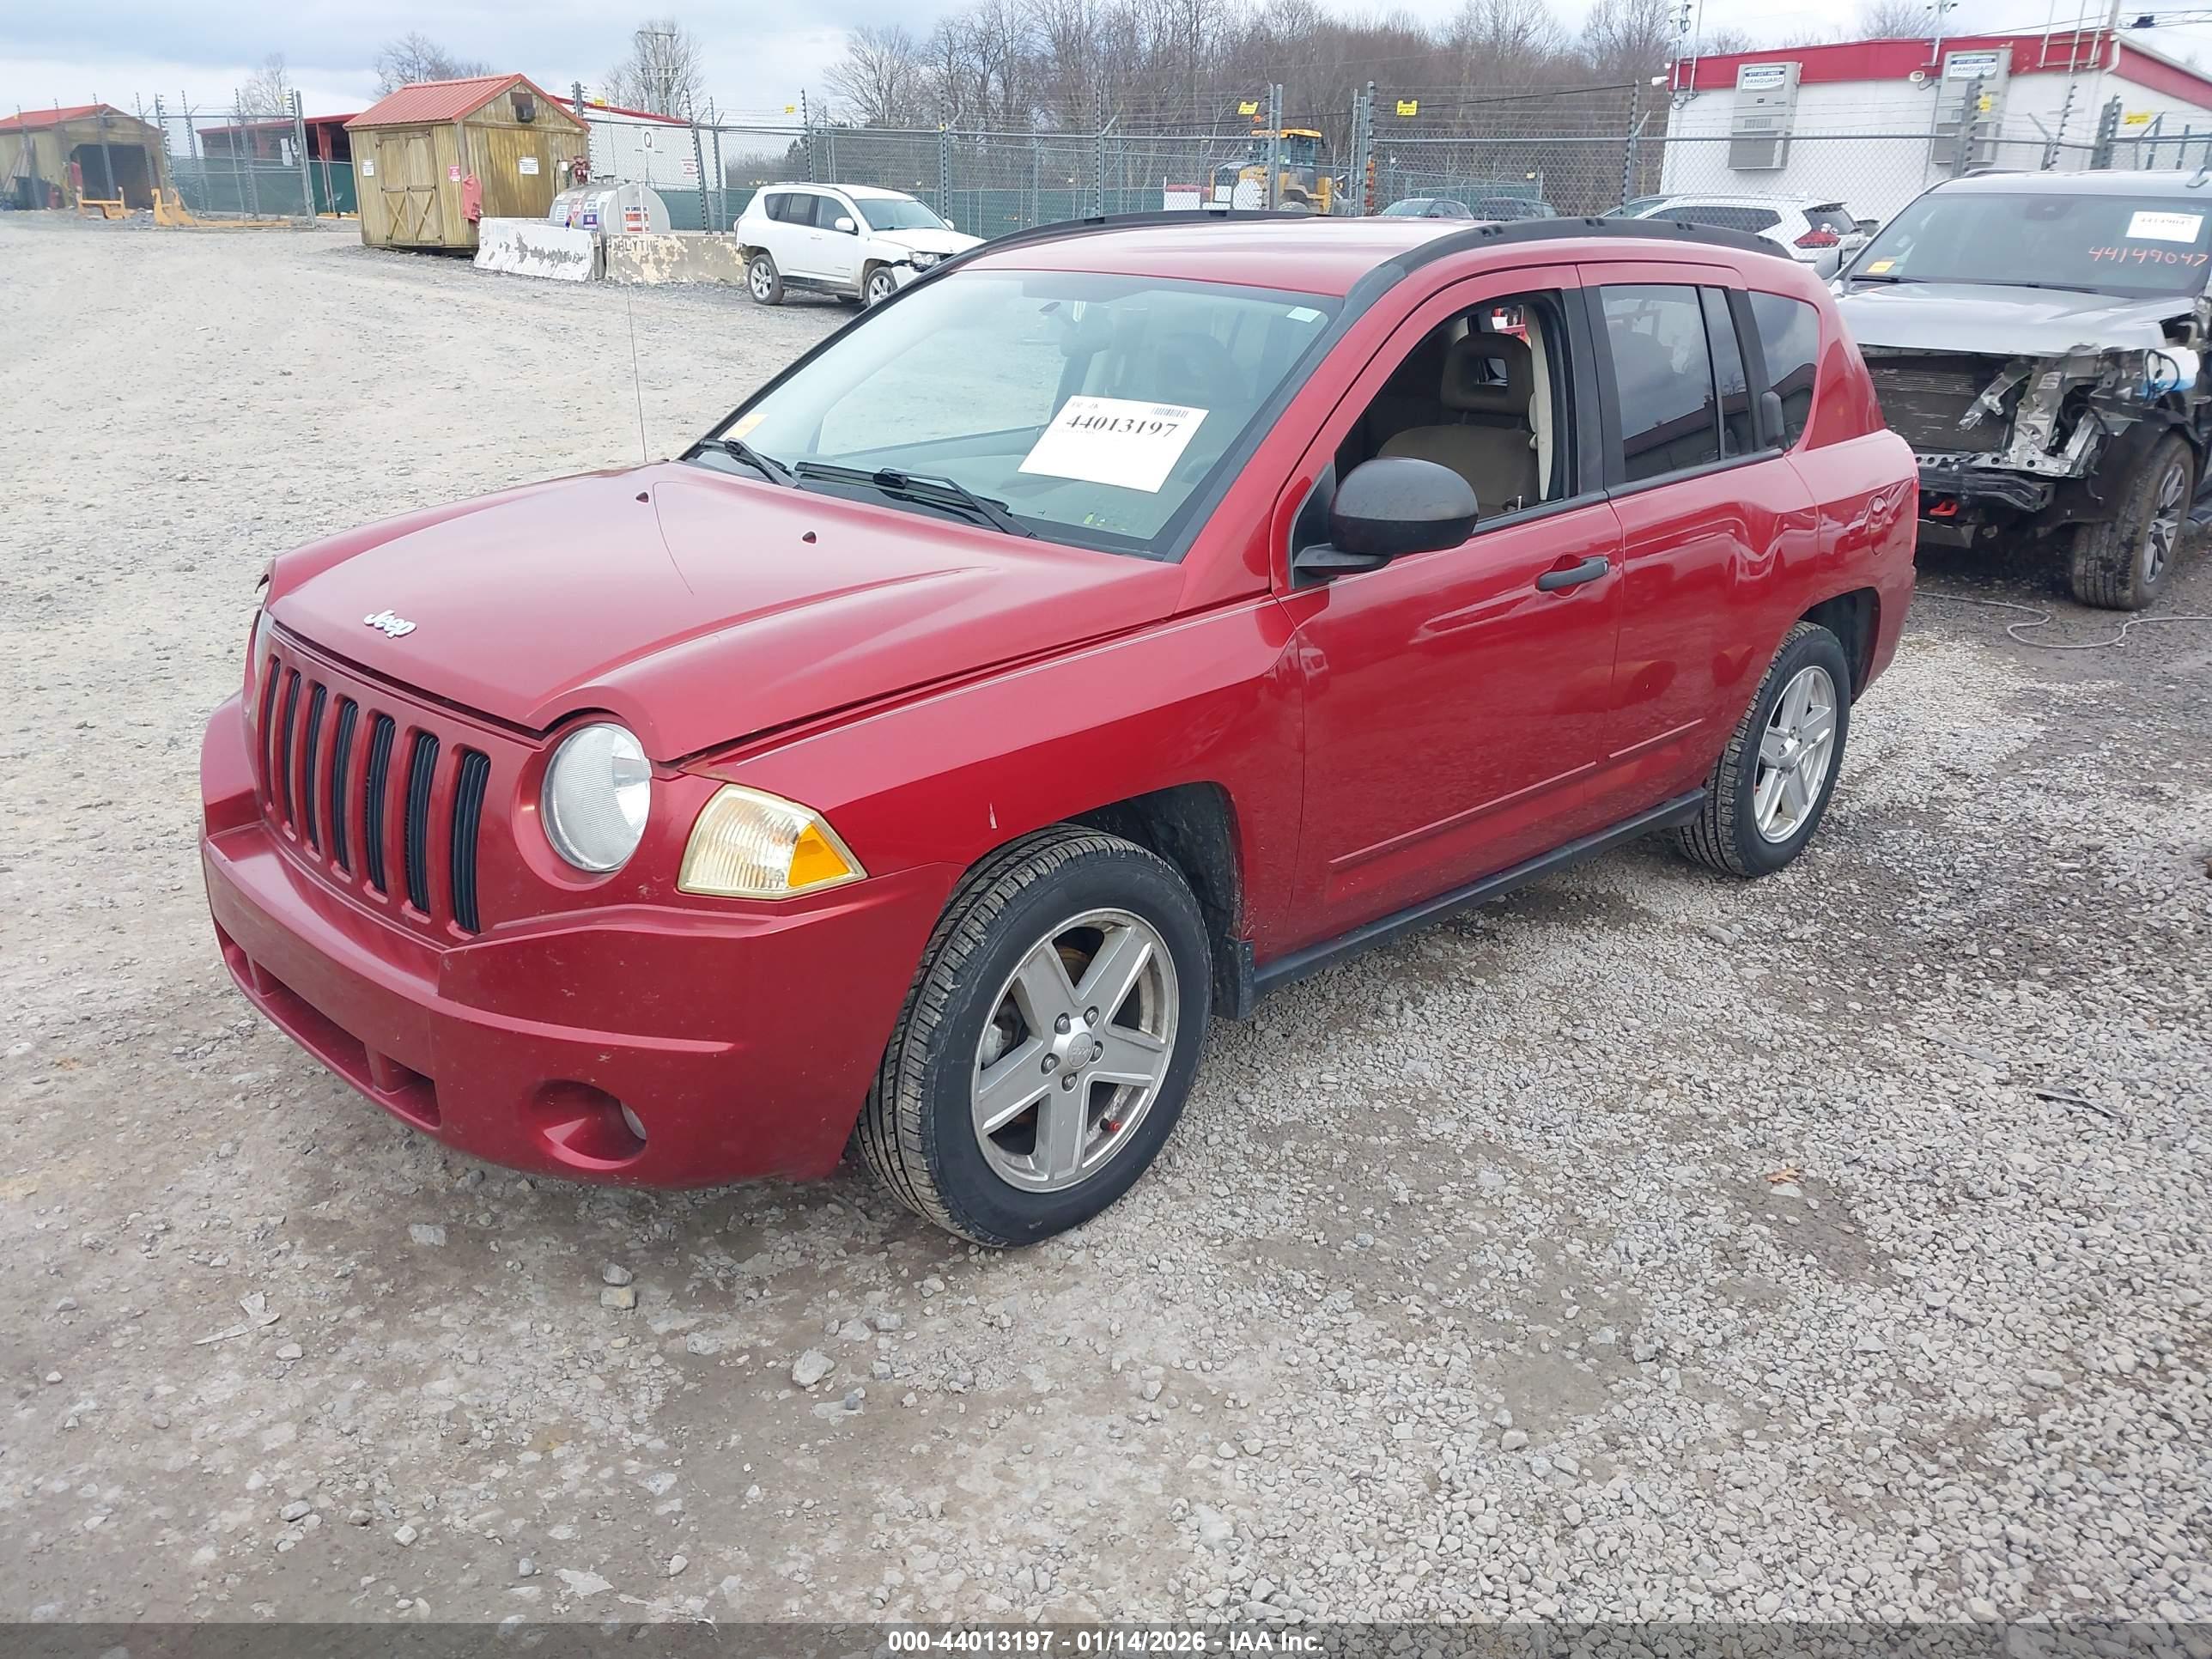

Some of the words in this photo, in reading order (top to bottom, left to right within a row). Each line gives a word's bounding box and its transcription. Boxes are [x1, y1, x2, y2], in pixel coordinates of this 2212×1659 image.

[644, 131, 653, 148] Q
[2088, 246, 2209, 267] 44149047
[1066, 414, 1179, 437] 44013197
[363, 609, 416, 639] Jeep
